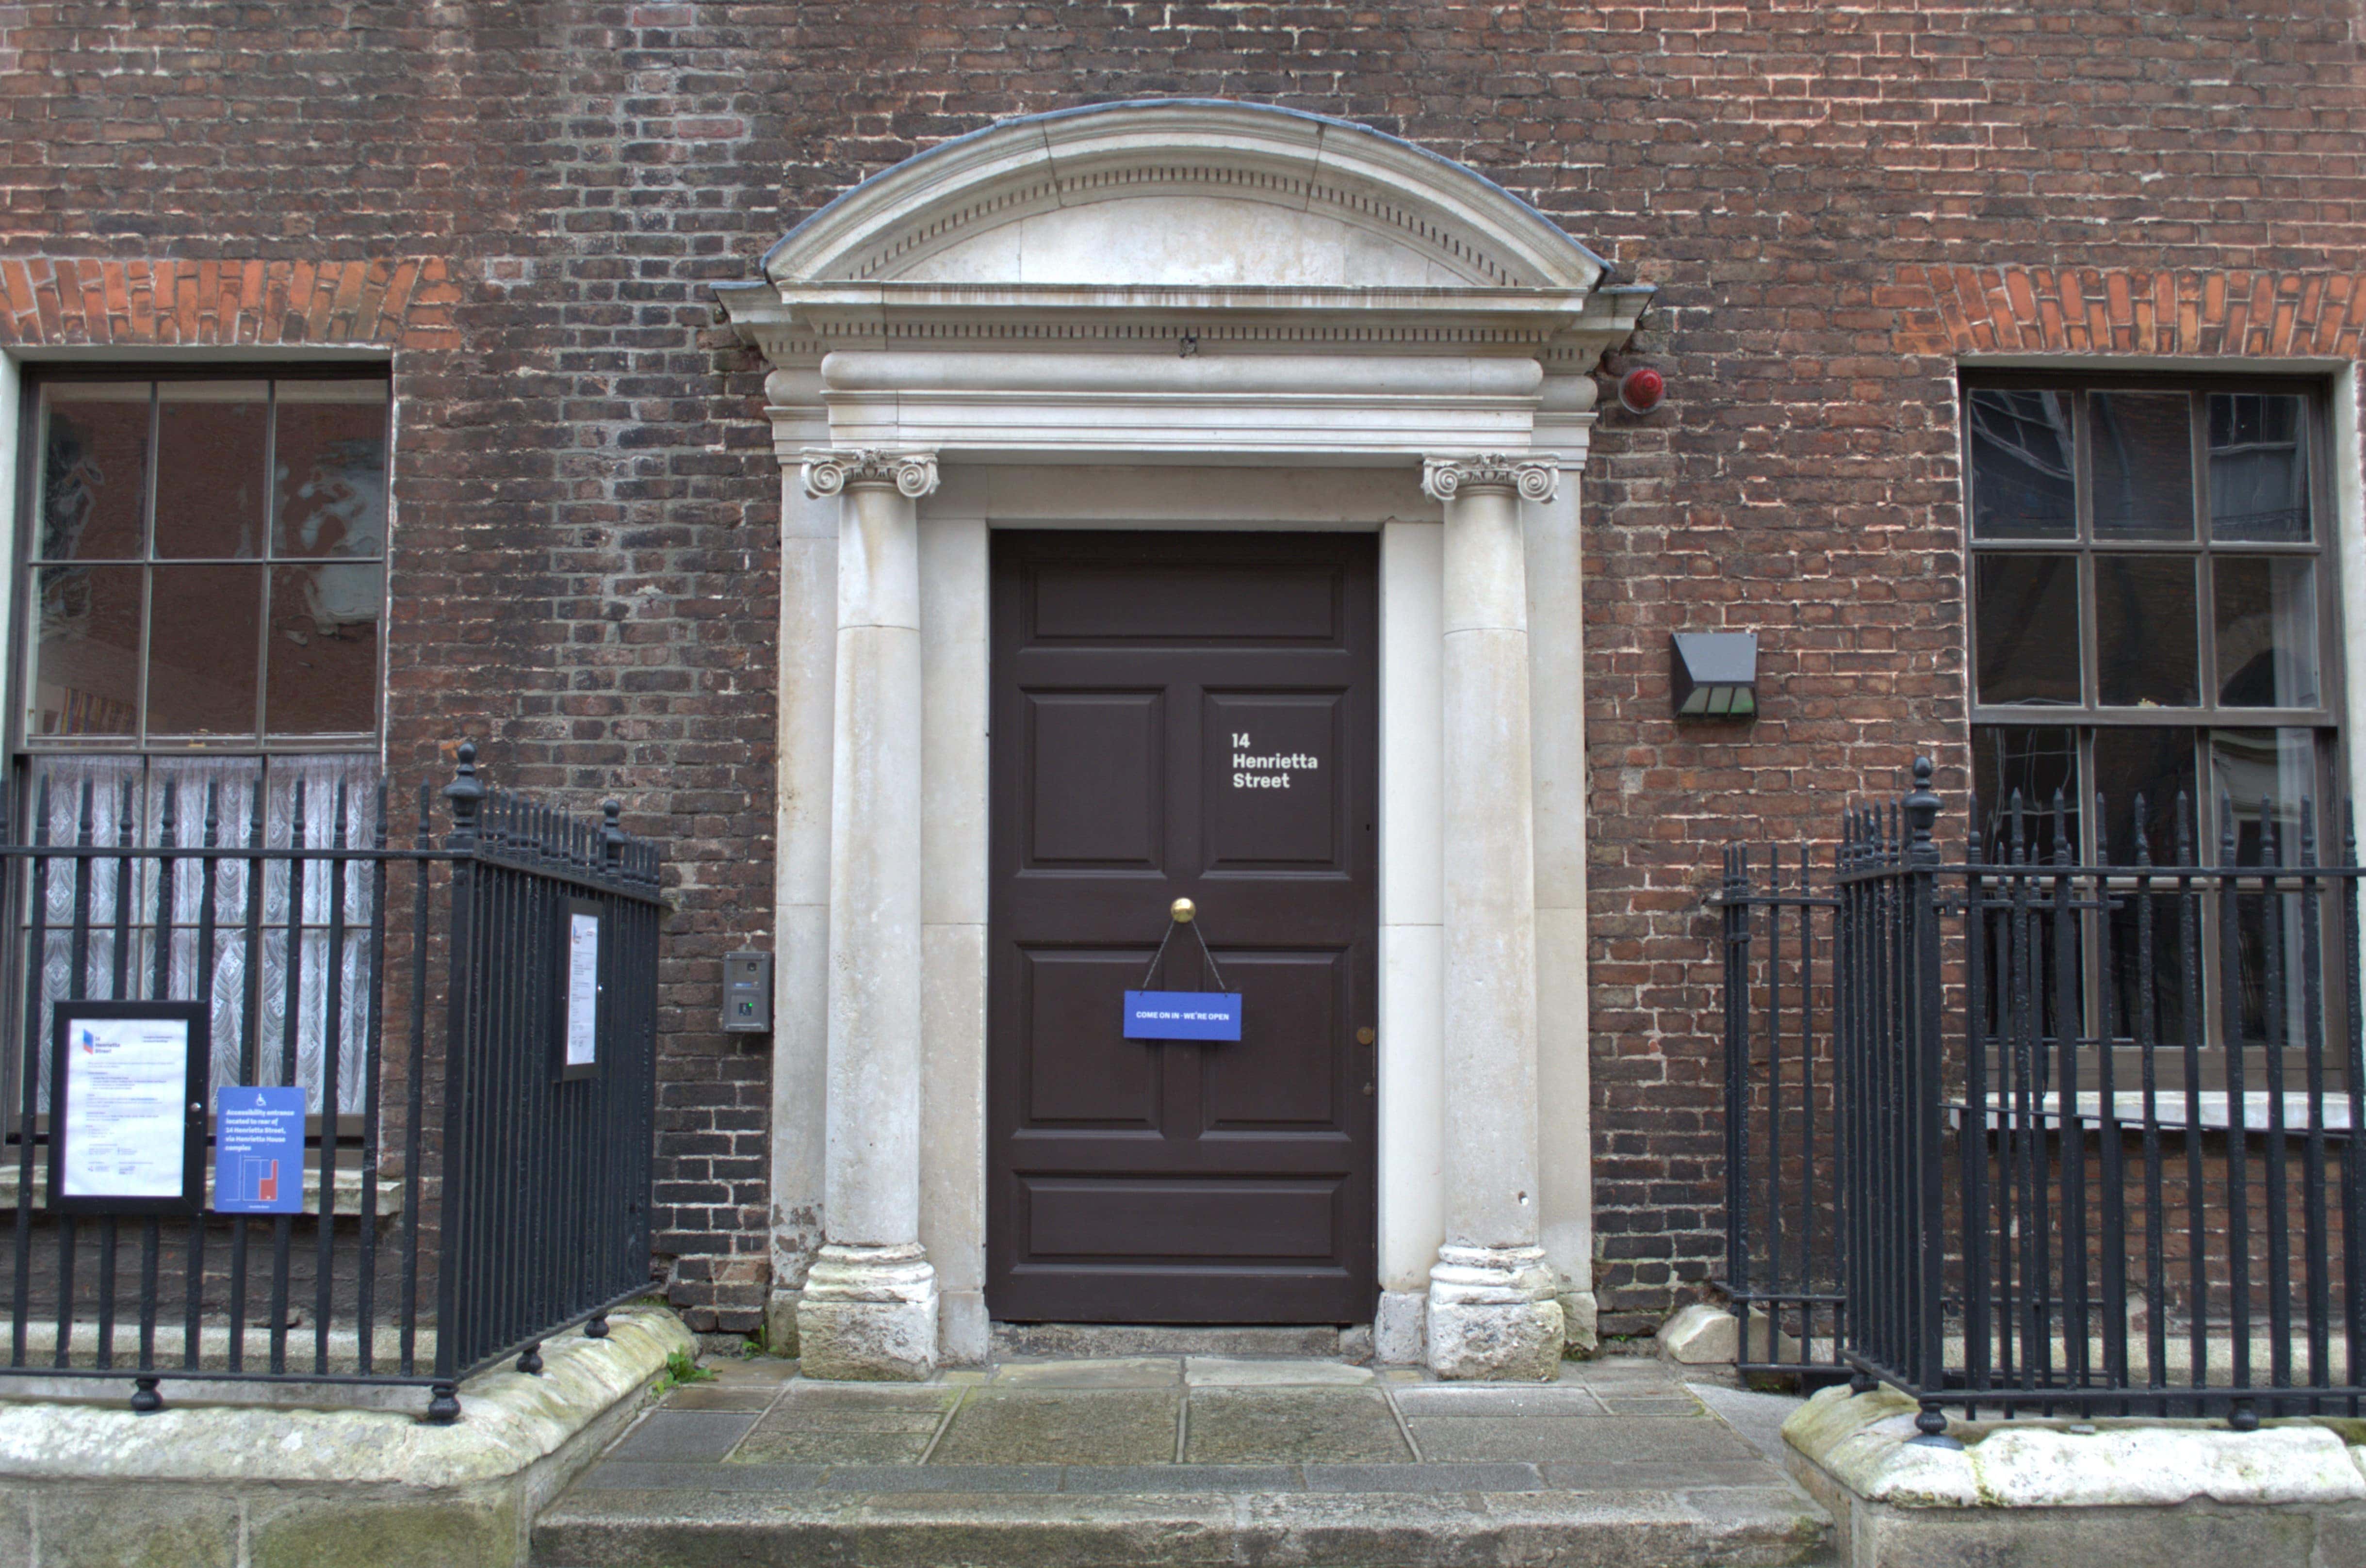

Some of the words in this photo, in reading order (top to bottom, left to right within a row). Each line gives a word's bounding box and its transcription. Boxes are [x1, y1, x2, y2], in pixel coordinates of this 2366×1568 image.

[1232, 733, 1250, 748] 14
[1233, 753, 1318, 769] Henrietta
[1233, 773, 1290, 788] Street
[227, 1109, 265, 1117] Accessibility
[271, 1117, 278, 1126] of
